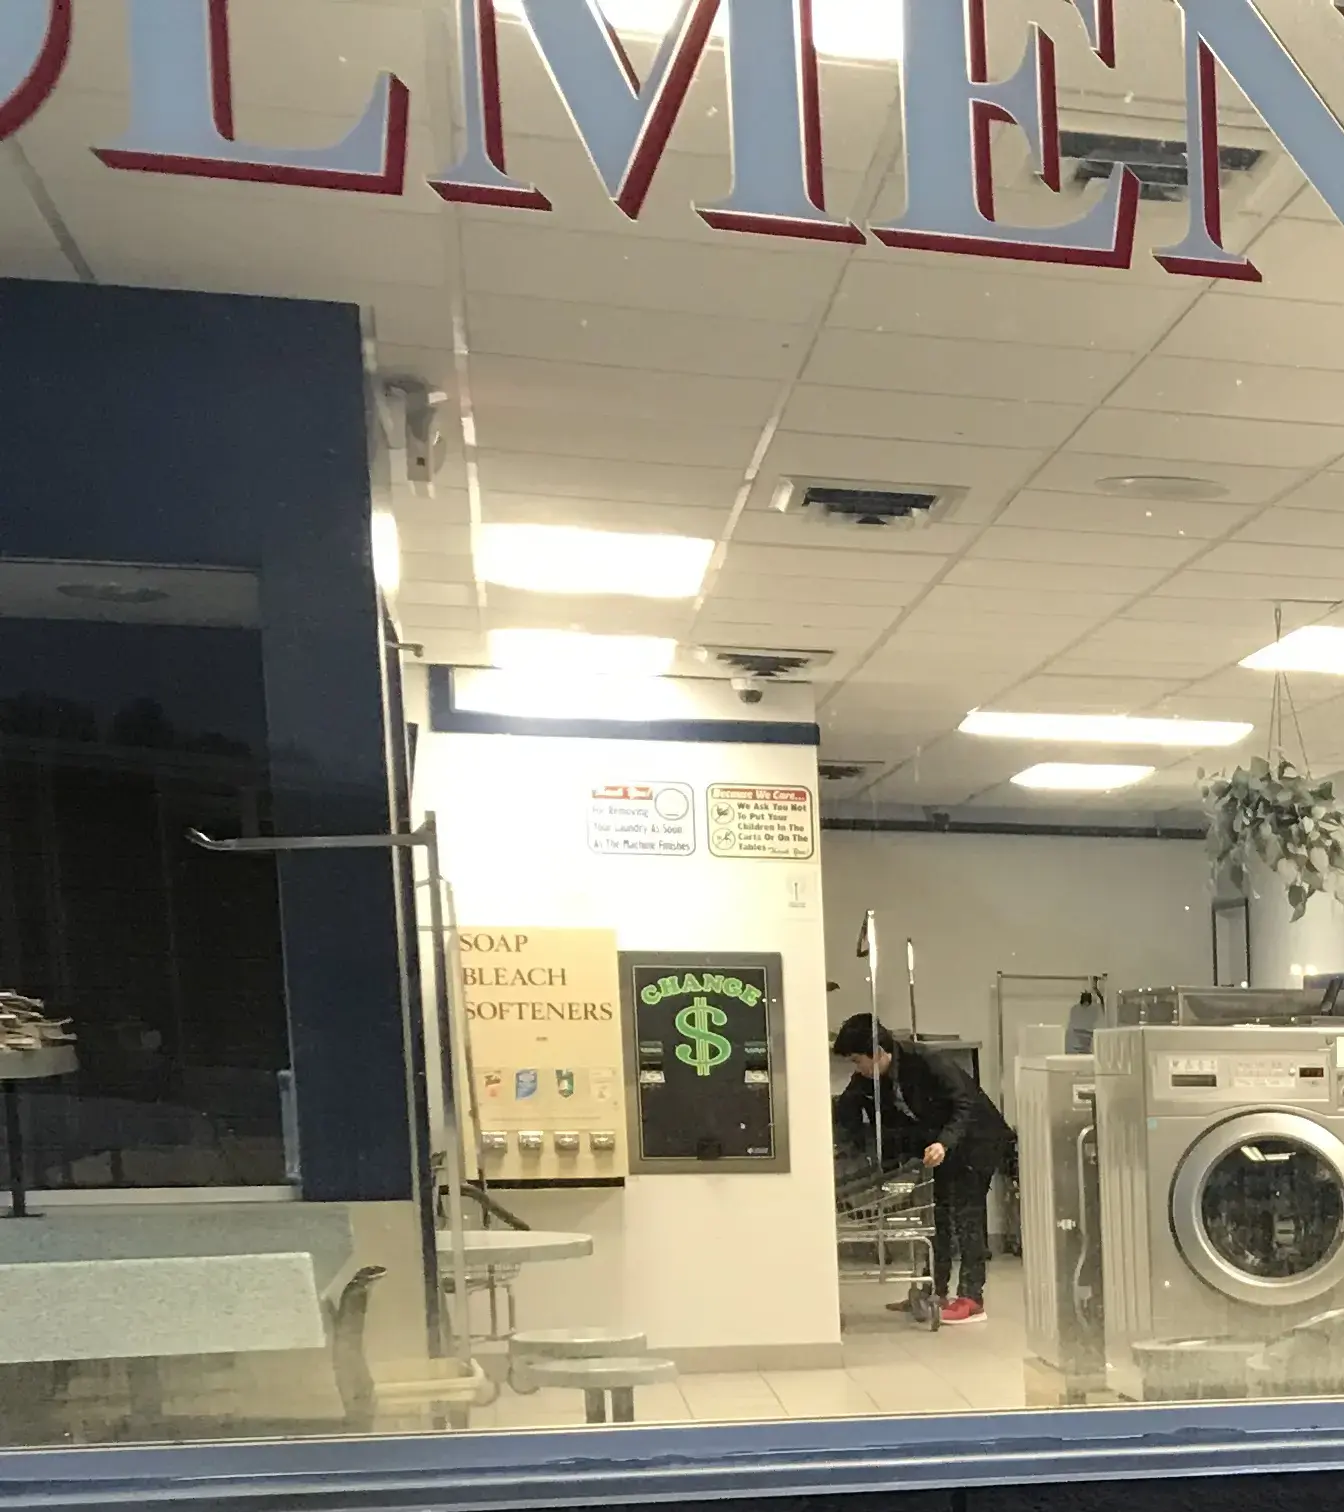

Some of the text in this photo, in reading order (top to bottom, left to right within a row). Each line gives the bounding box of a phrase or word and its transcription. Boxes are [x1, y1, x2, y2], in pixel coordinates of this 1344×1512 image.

[737, 802, 807, 812] We Ask You Not
[737, 812, 747, 820] To
[768, 813, 787, 821] Your
[737, 823, 775, 831] Children
[789, 824, 805, 832] The
[738, 833, 762, 841] Carts
[793, 834, 808, 842] The
[460, 933, 529, 953] SOAP
[464, 967, 567, 987] BLEACH
[641, 973, 762, 1007] CHANGE
[465, 1001, 613, 1022] SOFTENERS
[675, 997, 732, 1076] $
